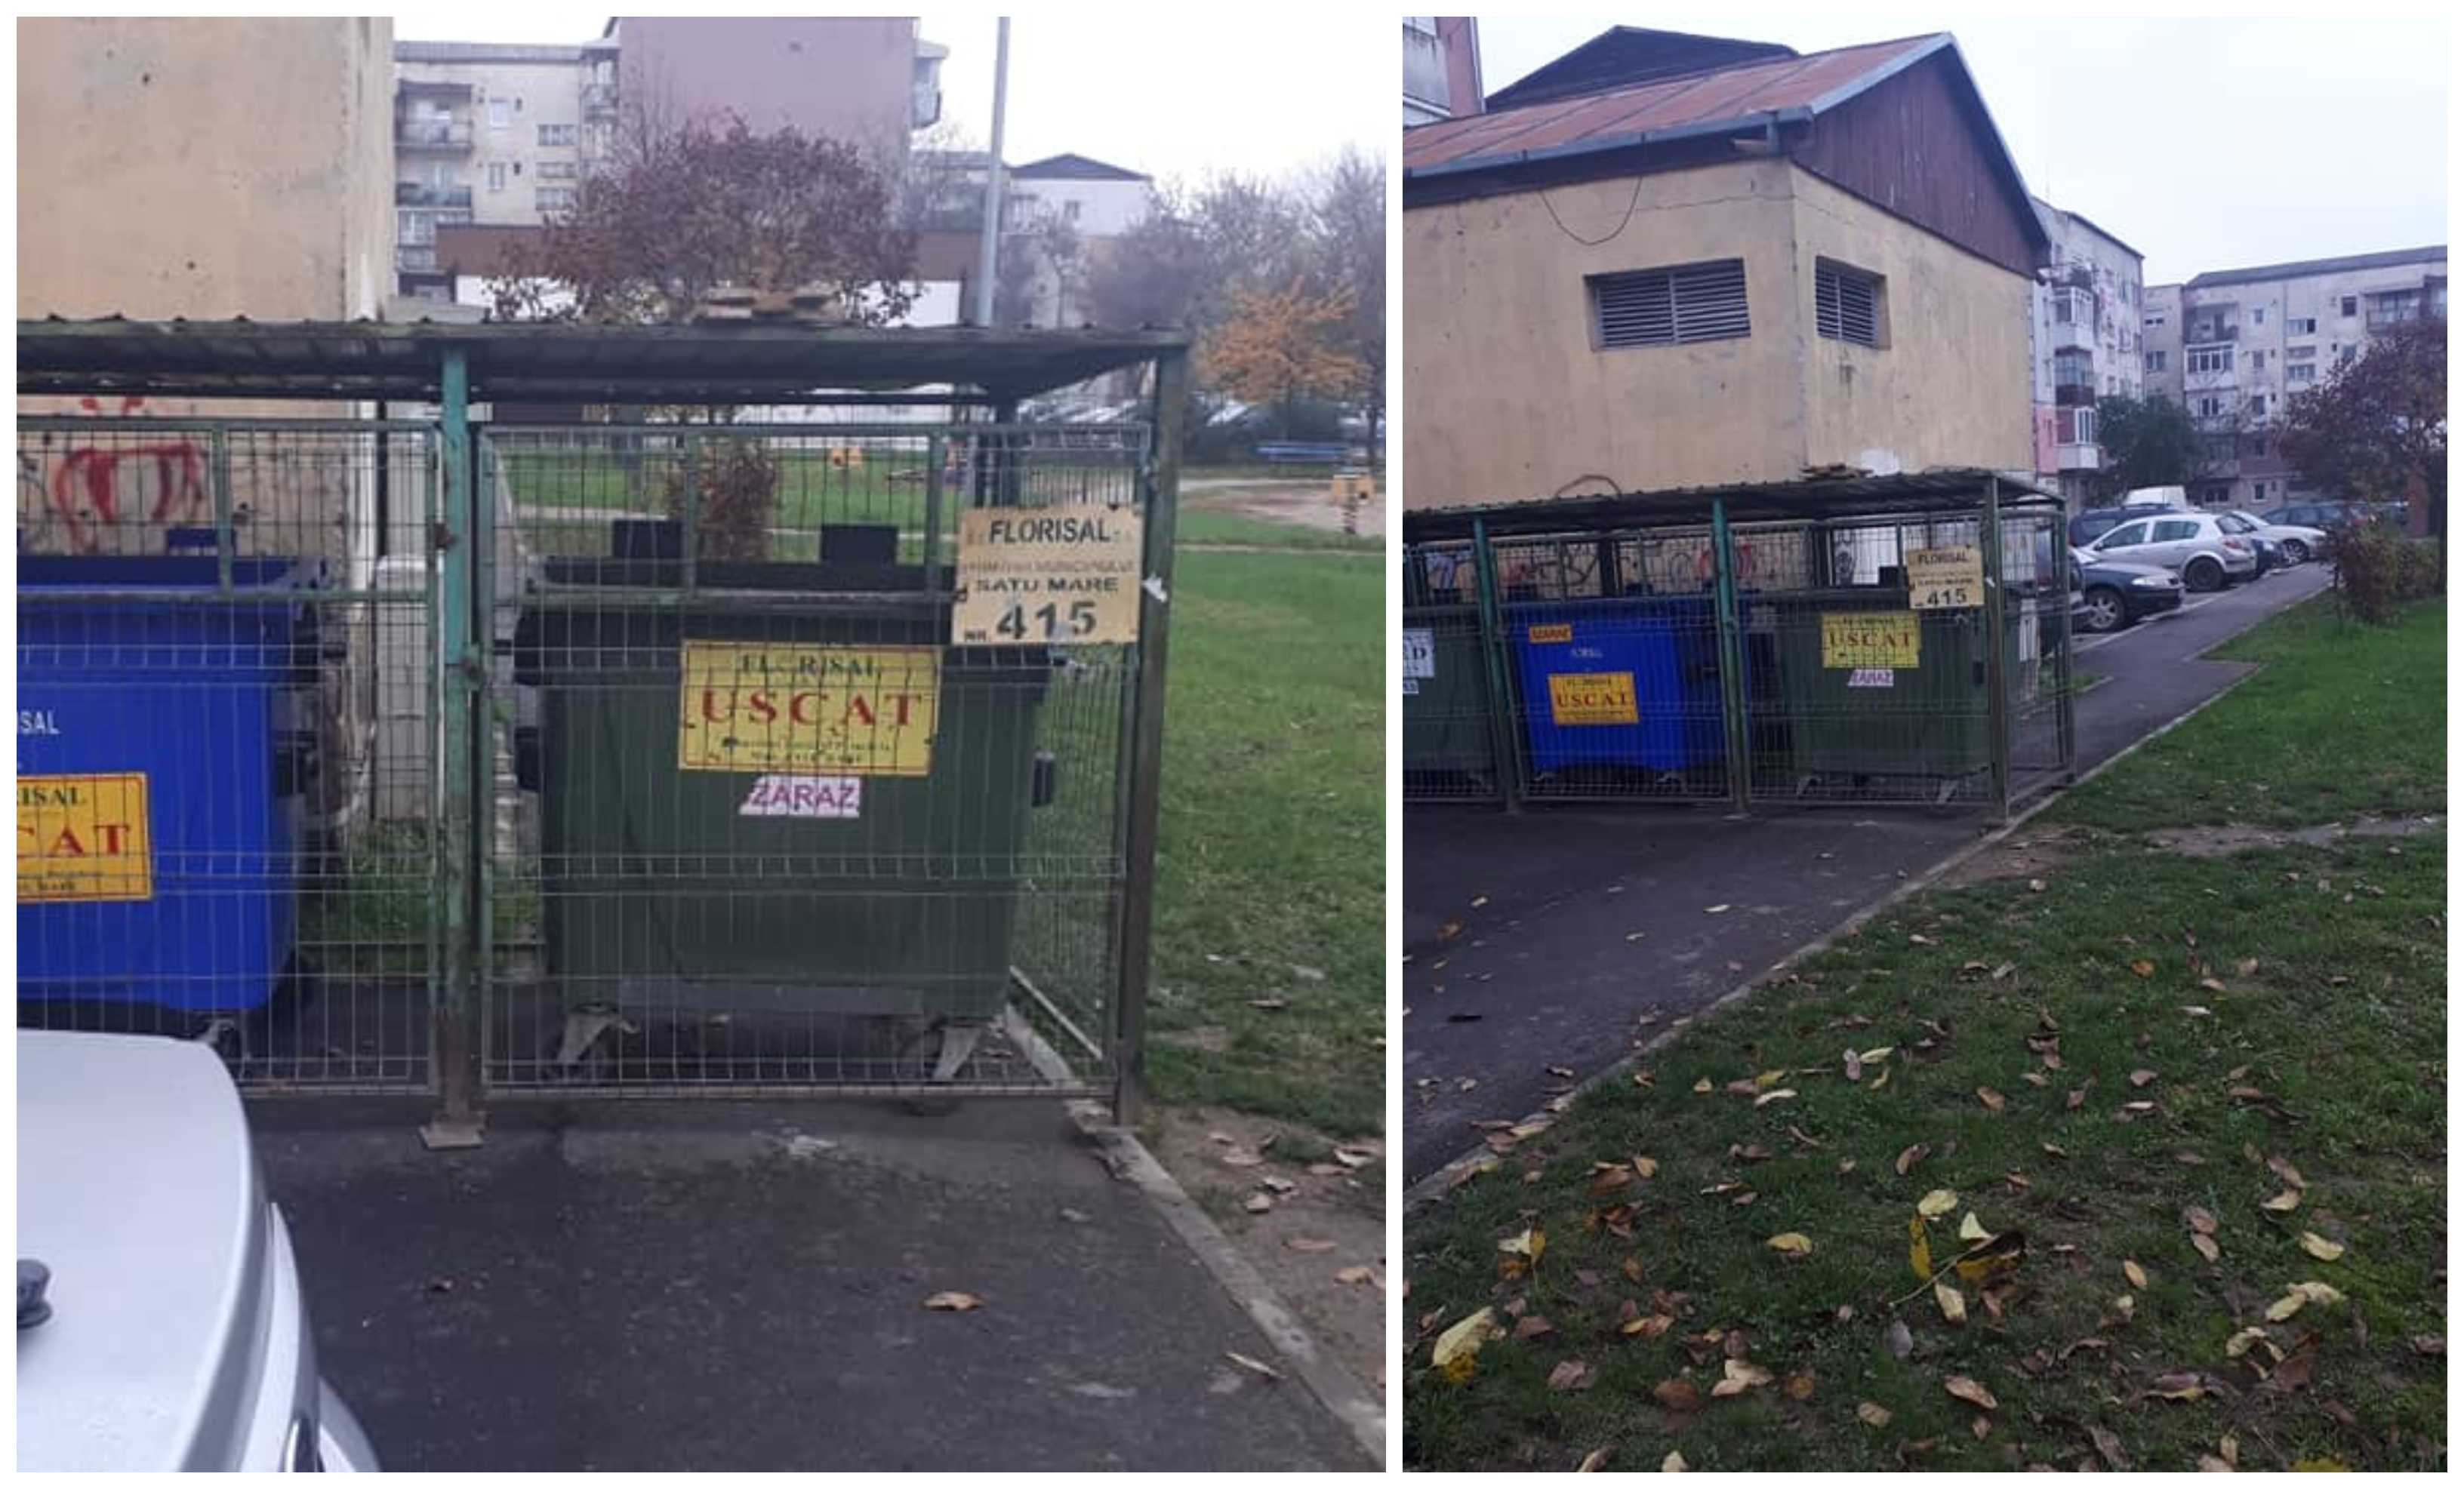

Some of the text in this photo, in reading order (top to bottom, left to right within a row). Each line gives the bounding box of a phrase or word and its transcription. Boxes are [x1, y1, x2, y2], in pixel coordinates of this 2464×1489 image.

[989, 517, 1110, 544] FLORISAL
[976, 577, 1119, 592] SATU MARE
[1927, 588, 1967, 605] 415
[996, 601, 1097, 640] 415
[702, 689, 921, 726] USCAT
